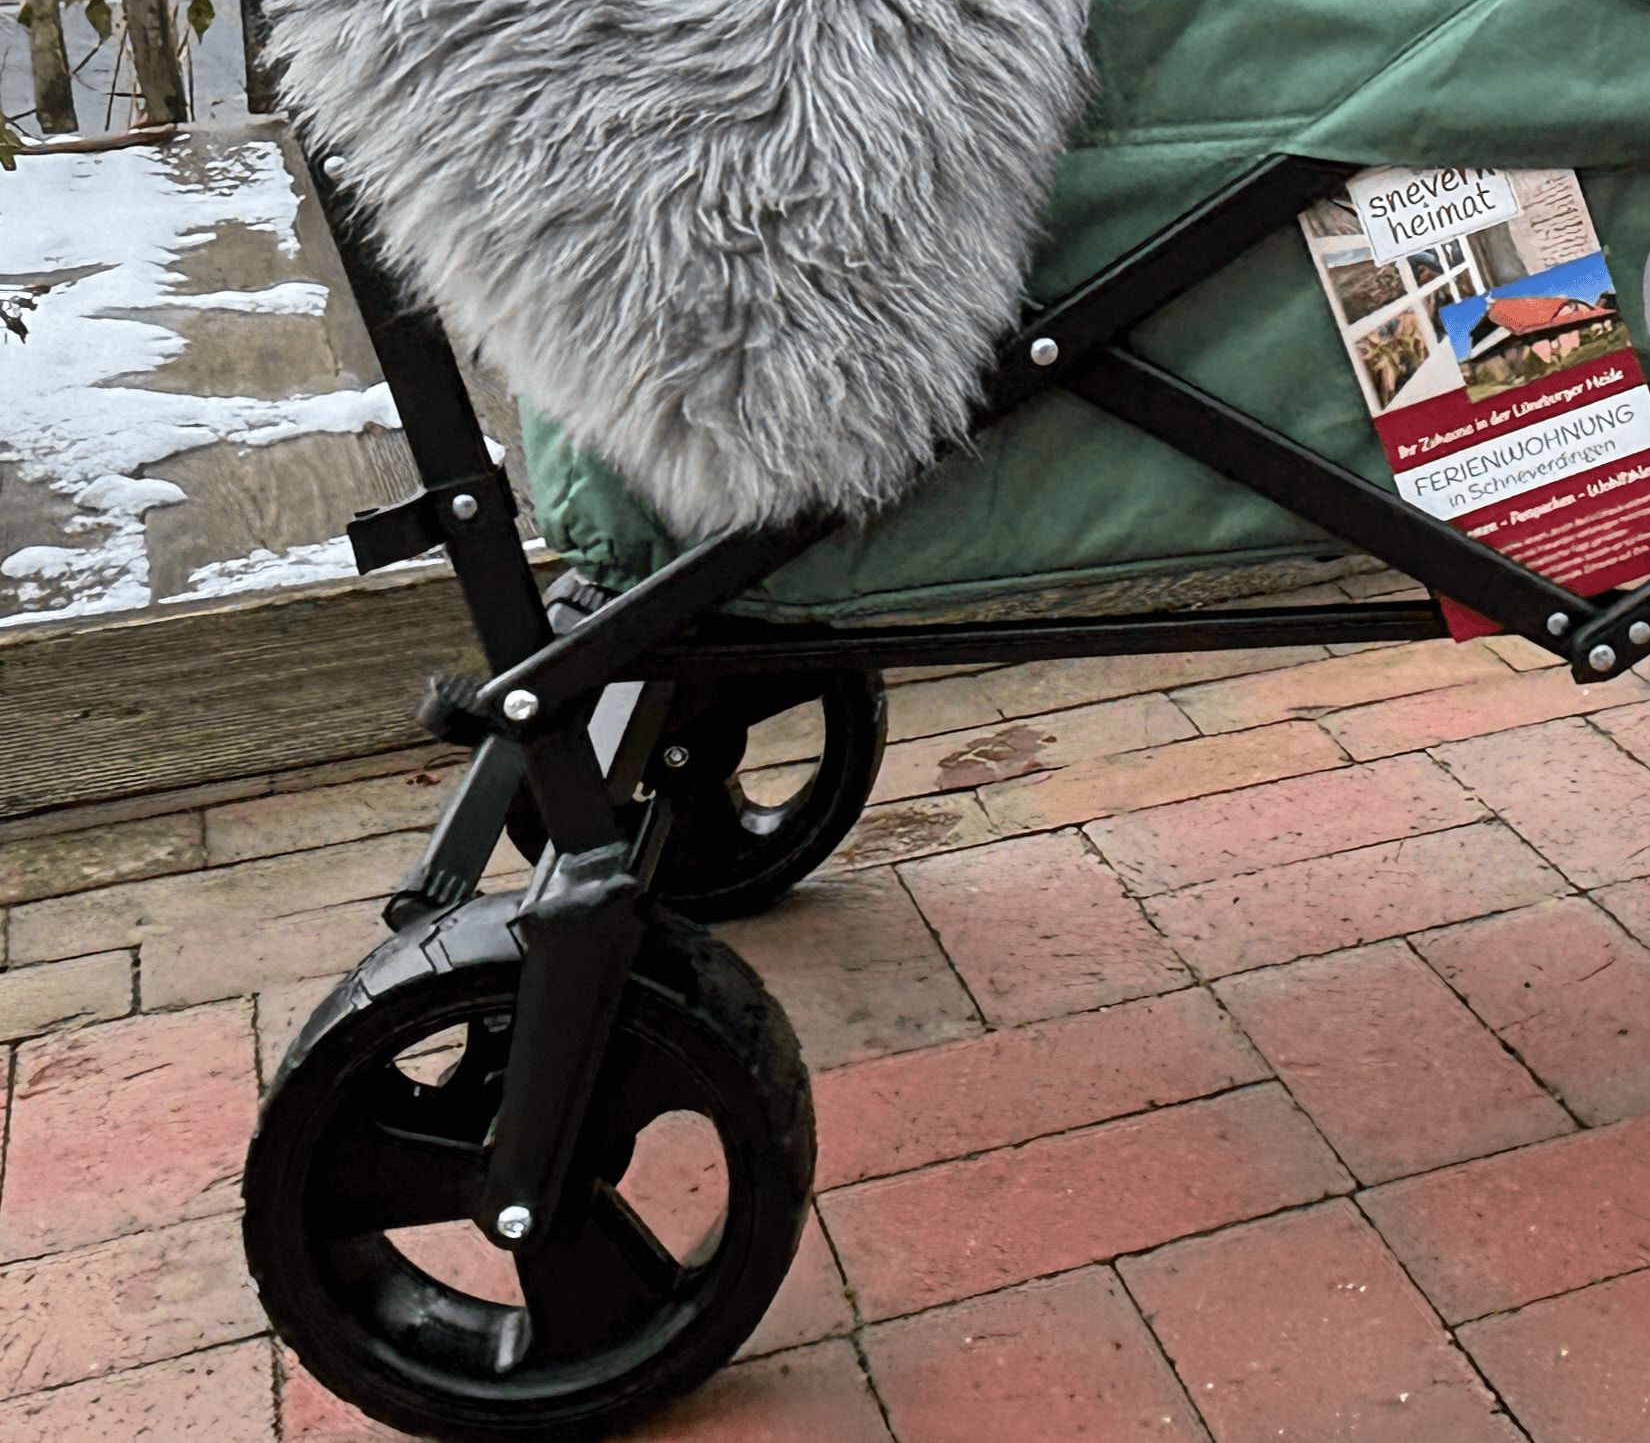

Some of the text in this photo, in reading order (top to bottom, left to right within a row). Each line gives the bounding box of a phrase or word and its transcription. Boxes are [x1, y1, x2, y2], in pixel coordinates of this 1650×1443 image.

[1386, 181, 1496, 244] heimat
[1414, 403, 1635, 497] FERIENWOHNUNG
[1448, 492, 1466, 508] in
